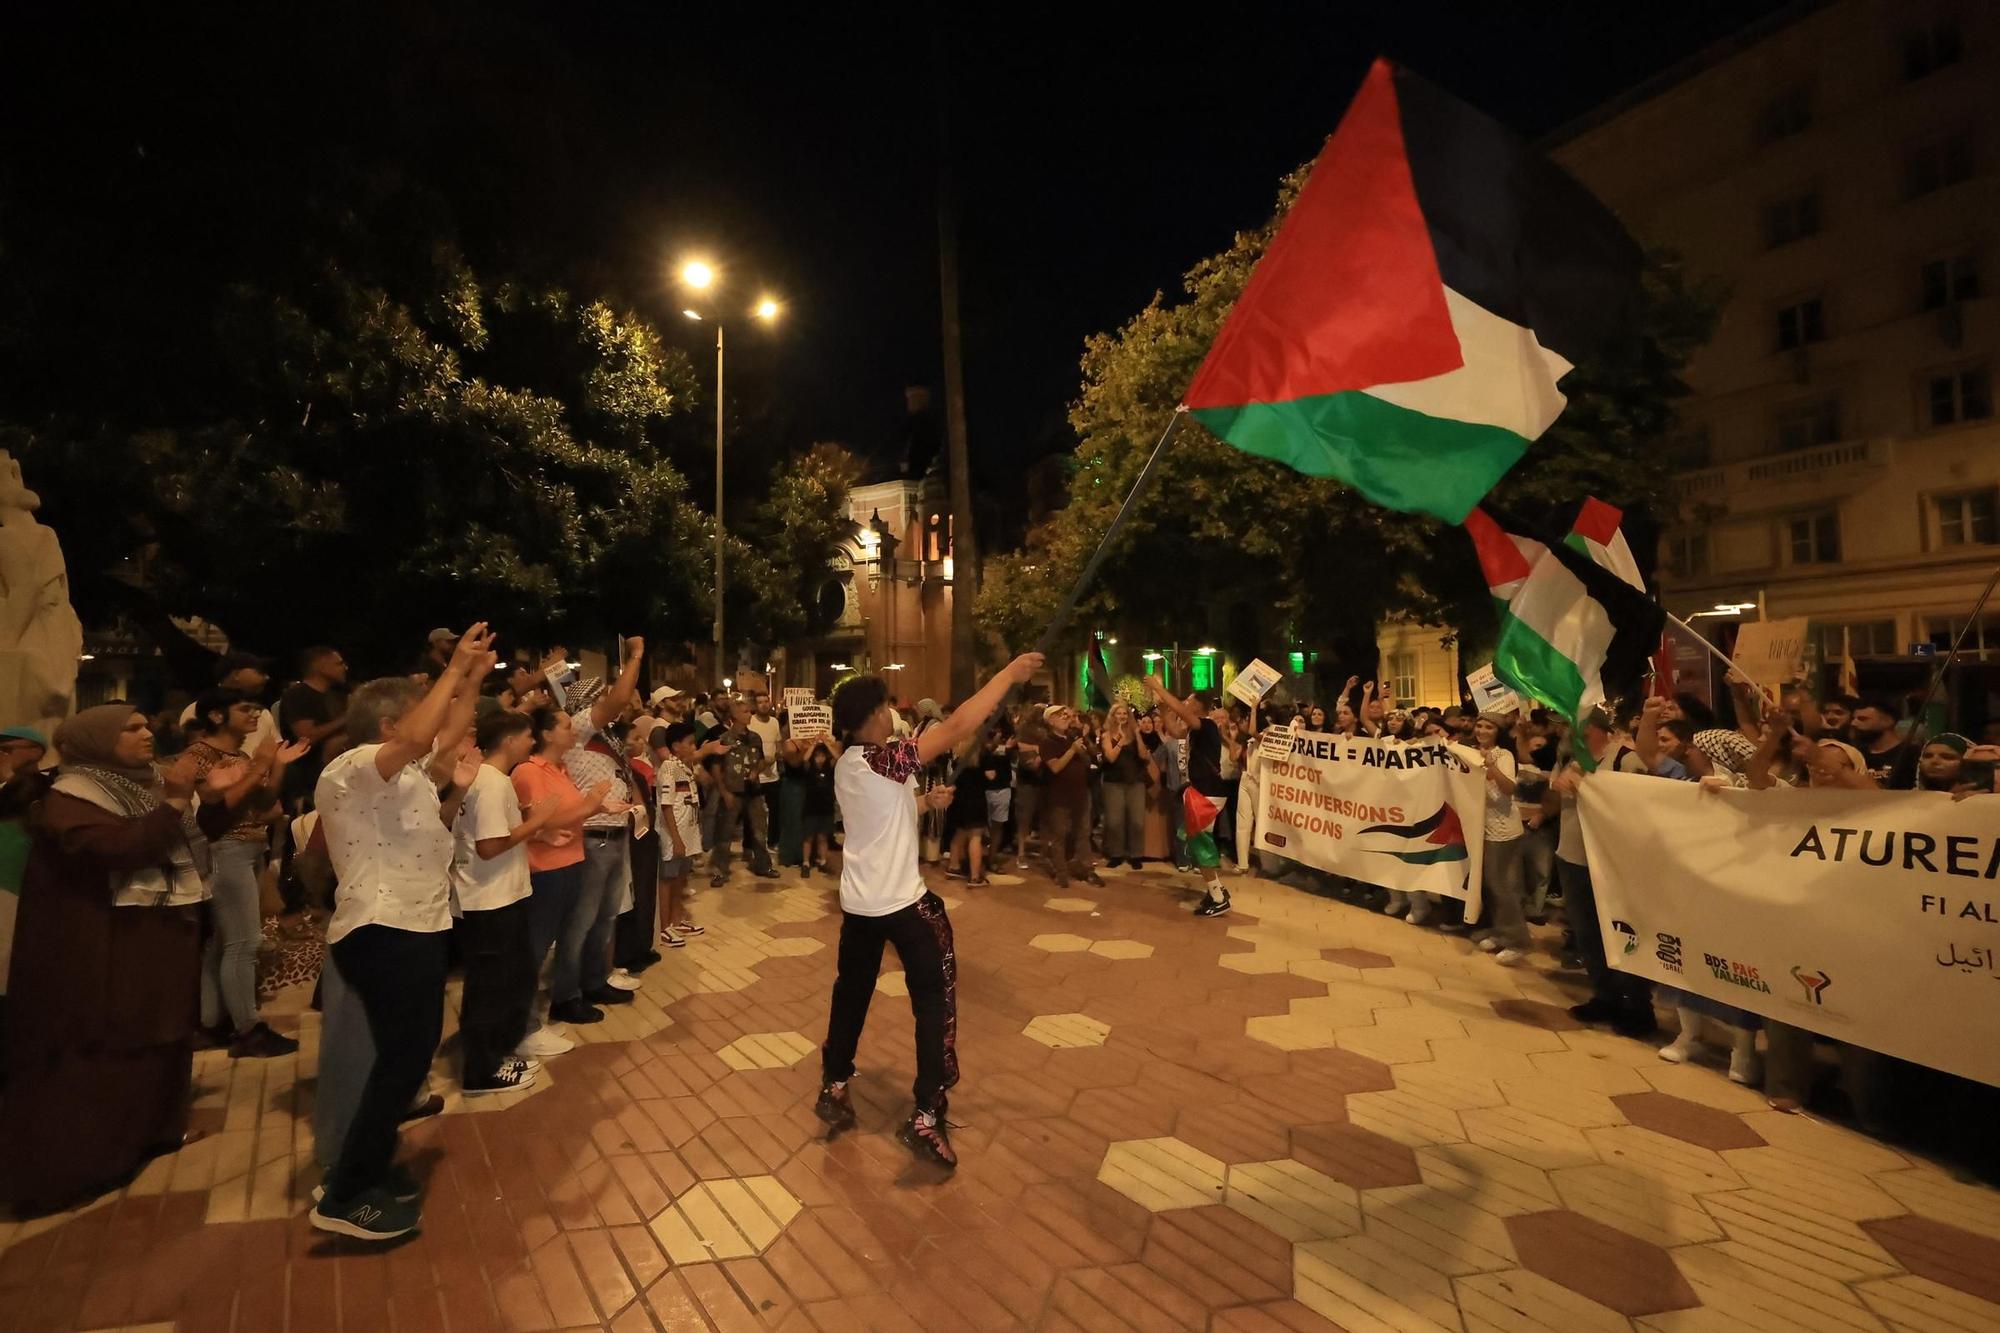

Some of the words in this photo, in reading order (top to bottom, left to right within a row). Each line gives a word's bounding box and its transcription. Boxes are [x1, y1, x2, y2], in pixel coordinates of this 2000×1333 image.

[1291, 737, 1340, 761] SRAEL
[1362, 743, 1470, 773] APARTHD
[1272, 761, 1323, 785] BOICOT
[1269, 783, 1405, 823] DESINVERSIONS
[1267, 807, 1343, 840] SANCIONS
[1790, 825, 2000, 879] ATURE
[1921, 894, 1946, 915] FI
[1959, 901, 1998, 923] AL
[1703, 952, 1729, 970] BDS
